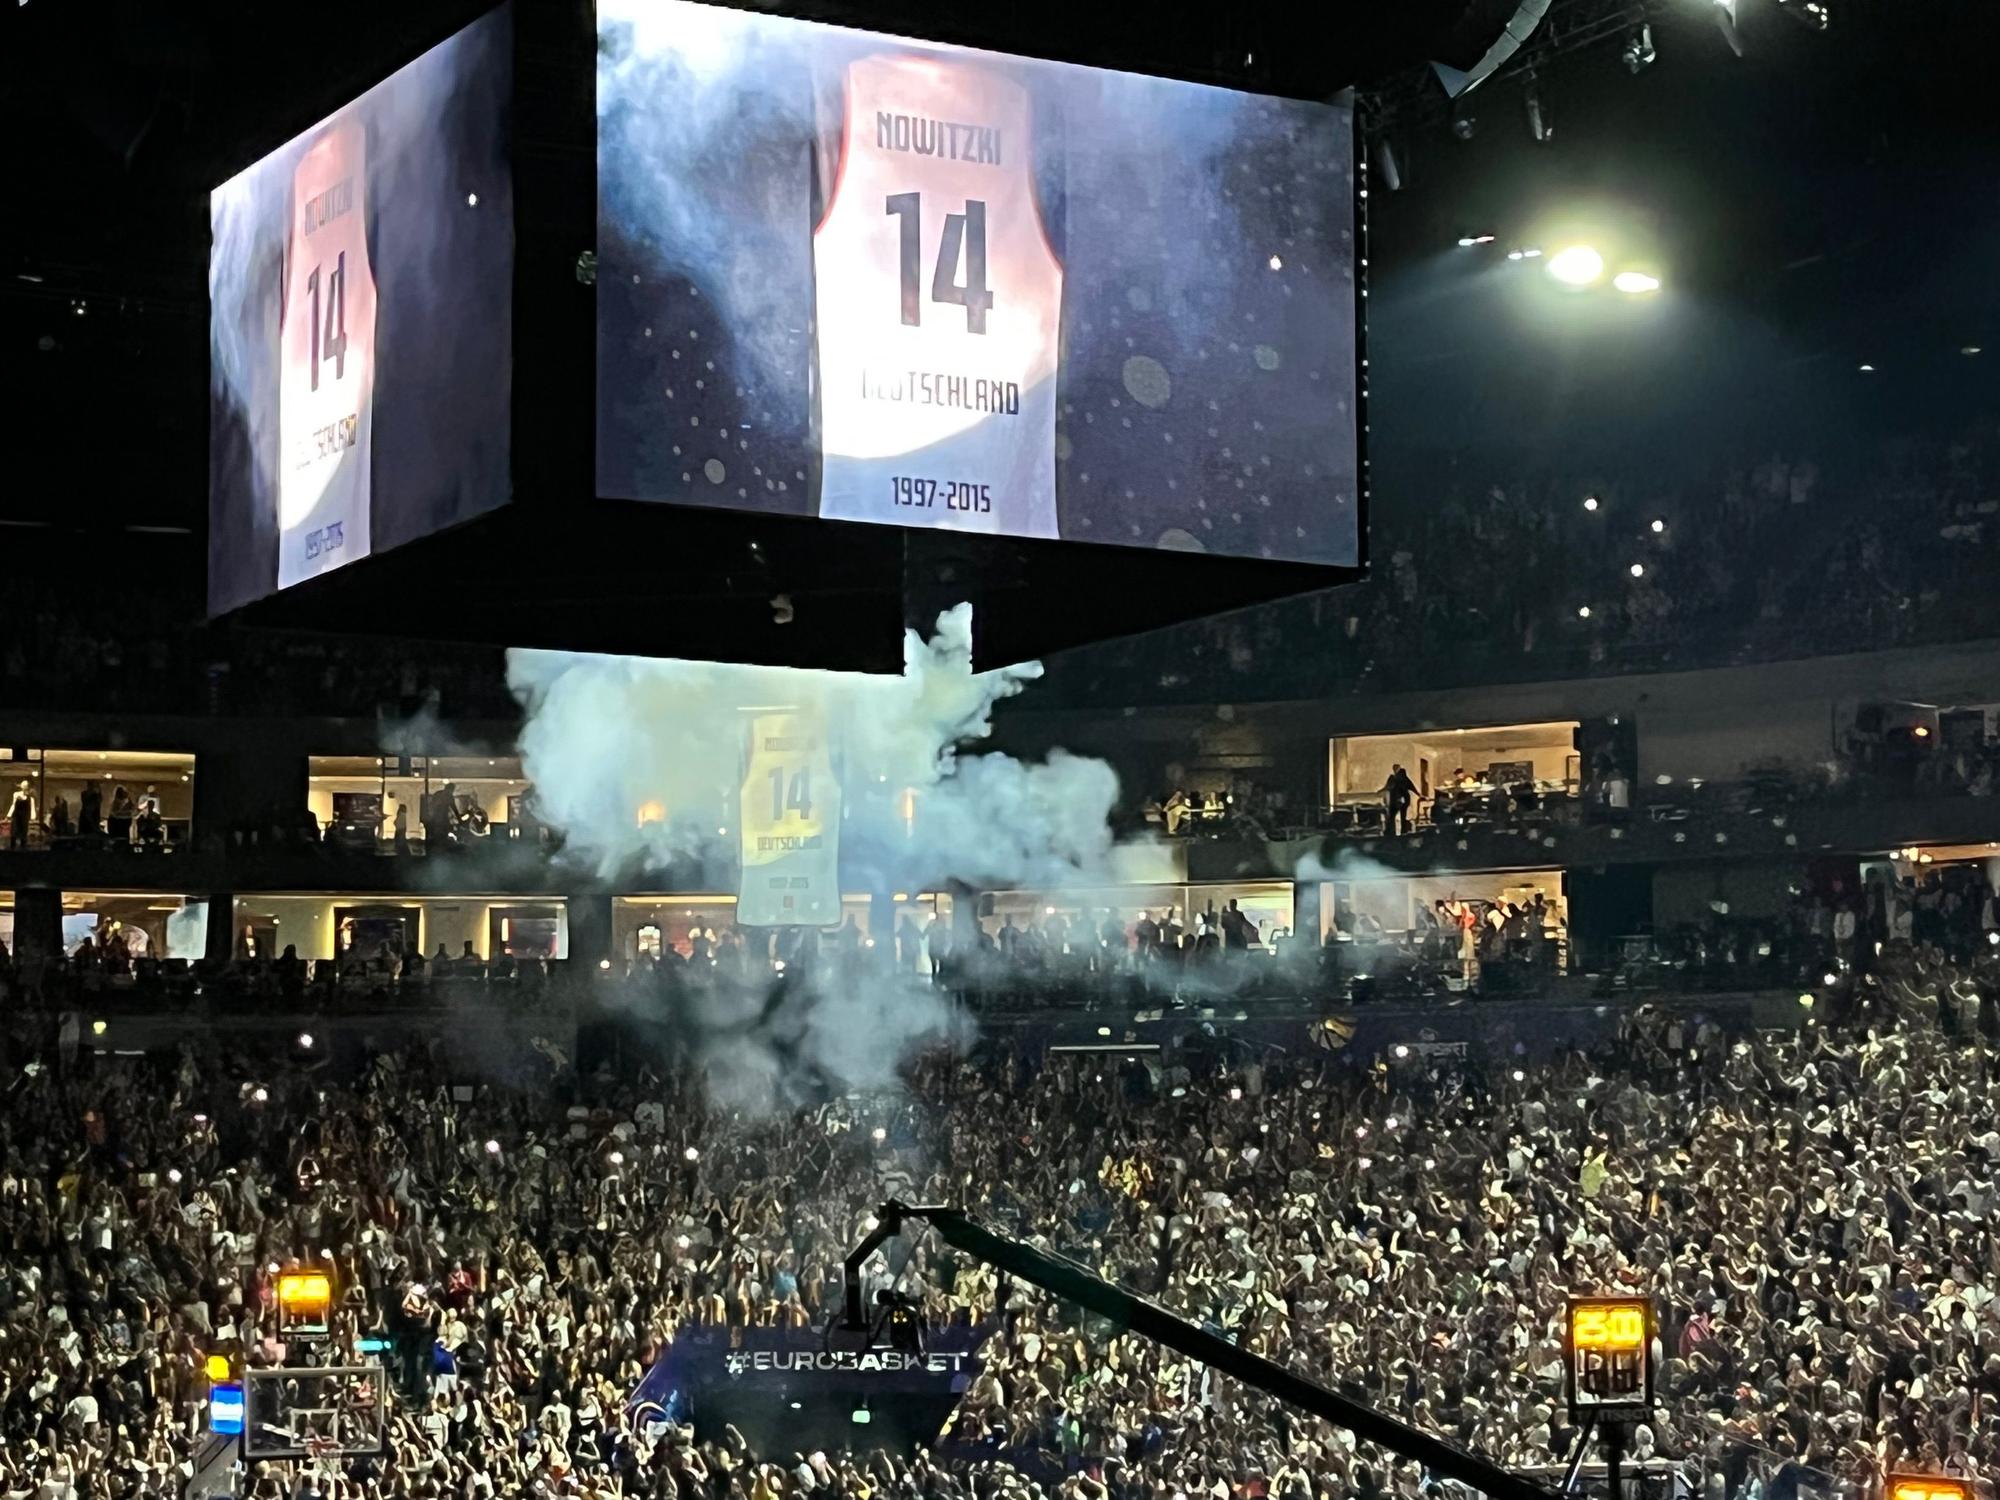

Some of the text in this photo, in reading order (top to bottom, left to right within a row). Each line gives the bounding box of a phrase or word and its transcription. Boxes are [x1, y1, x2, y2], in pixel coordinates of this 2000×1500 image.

[876, 111, 1001, 165] NOWITZKI
[886, 191, 994, 335] 14
[307, 250, 347, 392] 14
[891, 476, 991, 513] 1997-2015
[768, 766, 812, 821] 14
